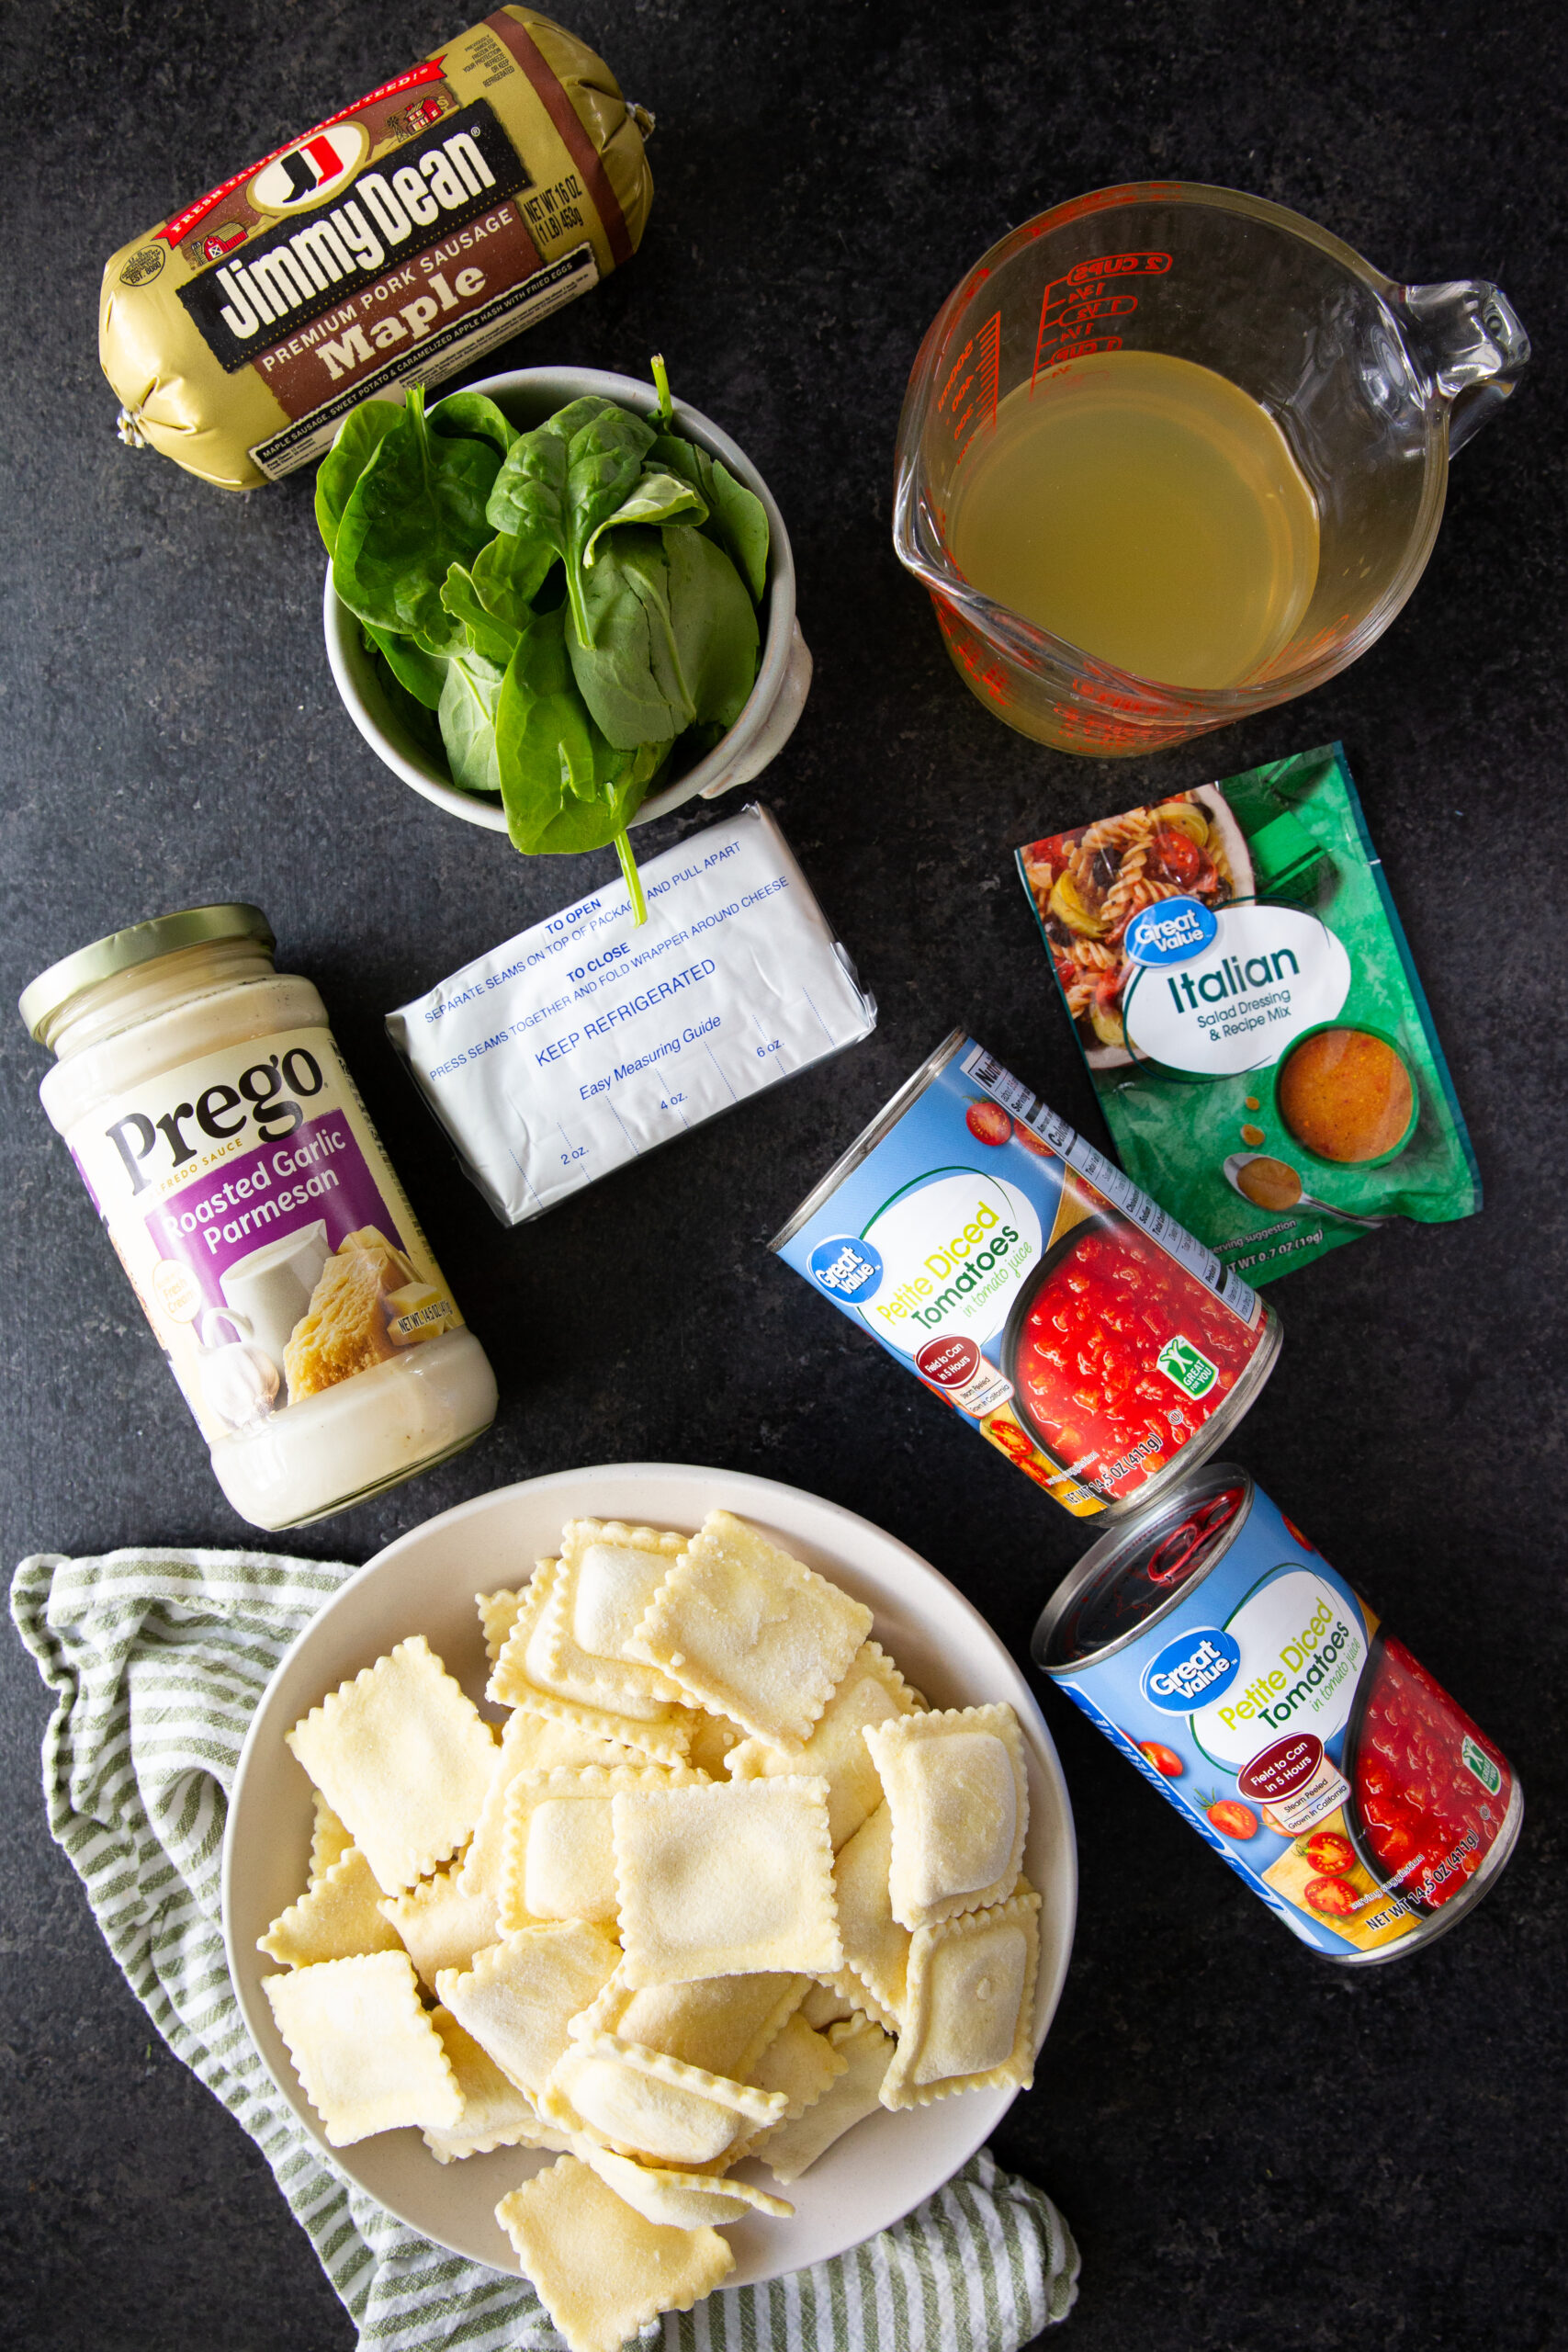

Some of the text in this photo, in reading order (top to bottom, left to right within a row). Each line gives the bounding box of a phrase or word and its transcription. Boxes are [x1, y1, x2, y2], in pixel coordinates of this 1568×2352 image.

[463, 48, 502, 73] YOUR PROTECTION
[472, 48, 489, 60] FROZEN
[482, 65, 514, 87] REFRIGERATED
[484, 51, 506, 68] REFREEZE
[491, 58, 509, 73] OR KEEP
[173, 188, 223, 232] FRESH
[523, 175, 582, 224] NET WT 16 OZ
[216, 202, 385, 340] Jimmy
[355, 132, 496, 246] Dean
[535, 206, 583, 245] (1 LB) 453g
[262, 304, 358, 372] PREMIUM
[360, 267, 417, 310] PORK
[420, 209, 513, 273] SAUSAGE
[315, 267, 486, 381] Maple
[263, 437, 291, 458] MAPLE
[331, 394, 357, 414] SWEET
[359, 373, 389, 396] POTATO
[390, 368, 397, 377] &
[398, 334, 452, 371] CARAMELIZED
[454, 320, 479, 338] APPLE
[481, 306, 502, 322] HASH
[504, 291, 525, 308] WITH
[526, 277, 549, 294] FRIED
[551, 263, 572, 279] EGGS
[424, 841, 742, 1023] SEPARATE SEAMS ON TOP OF PACKAG AND PULL APART
[545, 899, 602, 934] TO OPEN
[1134, 909, 1204, 953] Great Value
[430, 876, 789, 1081] PRESS SEAMS TOGETHER AND FOLD WRAPPER AROUND CHEESE
[567, 943, 631, 983] TO CLOSE
[1168, 948, 1301, 1013] Italian
[536, 958, 716, 1067] KEEP REFRIGERATED
[1197, 989, 1292, 1028] Salad Dressing
[1210, 1006, 1292, 1041] & Recipe Mix
[580, 1015, 721, 1101] Easy Measuring Guide
[756, 1039, 784, 1058] 6 oz.
[106, 1048, 322, 1195] Prego
[660, 1092, 688, 1111] 4 oz.
[156, 1138, 243, 1196] FREDO SAUCE
[560, 1146, 590, 1165] 2 oz.
[162, 1129, 346, 1240] Roasted Garlic
[203, 1169, 340, 1255] Parmesan
[1139, 1206, 1152, 1225] Sodium
[1245, 1220, 1296, 1243] suggestion
[815, 1246, 874, 1295] Great Value
[876, 1201, 999, 1326] Petite Diced
[1237, 1255, 1257, 1271] WT
[1258, 1248, 1276, 1262] 0.7
[1279, 1241, 1293, 1255] OZ
[1295, 1229, 1323, 1250] (19g)
[911, 1226, 1019, 1329] Tomatoes
[959, 1241, 1032, 1317] in tomato juice
[1205, 1265, 1217, 1284] Protein
[398, 1306, 435, 1334] NET WT. 14.5
[924, 1343, 964, 1374] Field to Can
[937, 1355, 971, 1381] in 5 Hours
[1182, 1359, 1205, 1387] GREAT
[1190, 1368, 1213, 1392] FOR YOU
[985, 1384, 1010, 1404] California
[1063, 1490, 1080, 1506] NET
[1076, 1485, 1096, 1500] WT
[1089, 1471, 1114, 1494] 14.5
[1110, 1461, 1129, 1479] OZ
[1122, 1432, 1164, 1469] (411g)
[1149, 1639, 1232, 1700] Great Value
[1217, 1596, 1334, 1731] Petite Diced
[1258, 1621, 1349, 1730] Tomatoes
[1309, 1635, 1360, 1713] in tomato juice
[1250, 1742, 1308, 1786] Field to Can
[1264, 1756, 1312, 1793] in 5 Hours
[1283, 1778, 1328, 1814] Steam Peeled
[1288, 1784, 1348, 1830] Grown In California
[1349, 1853, 1425, 1910] serving suggestion
[1366, 1828, 1481, 1931] NET WT 14.5 OZ (411g)
